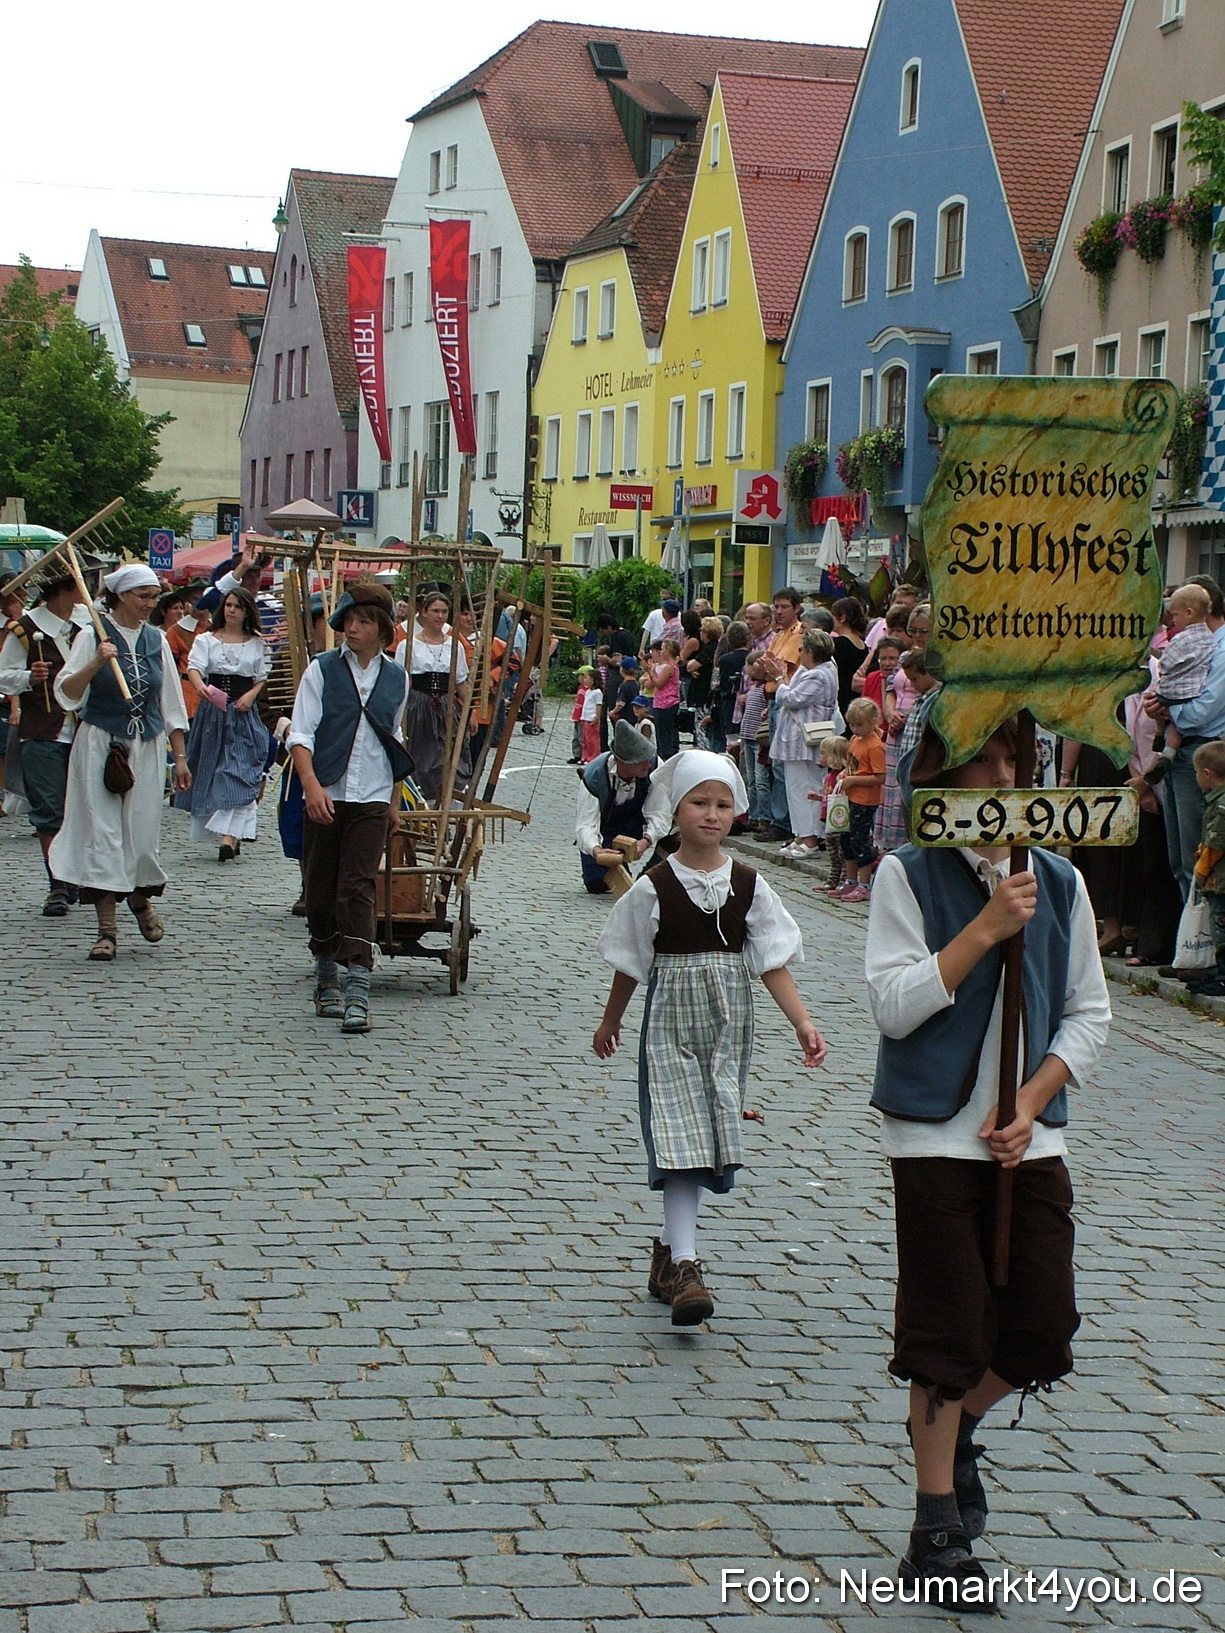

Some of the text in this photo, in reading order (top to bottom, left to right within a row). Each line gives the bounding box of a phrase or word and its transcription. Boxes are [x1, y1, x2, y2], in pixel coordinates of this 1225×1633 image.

[585, 368, 654, 400] HOTEL Lehmeier
[946, 459, 1149, 505] Historisches
[342, 495, 369, 520] KL
[675, 484, 682, 512] P
[578, 507, 618, 526] Restaurant
[151, 556, 171, 567] TAXI
[946, 519, 1152, 585] Tillyfest
[937, 601, 1147, 642] Breitenbrunn
